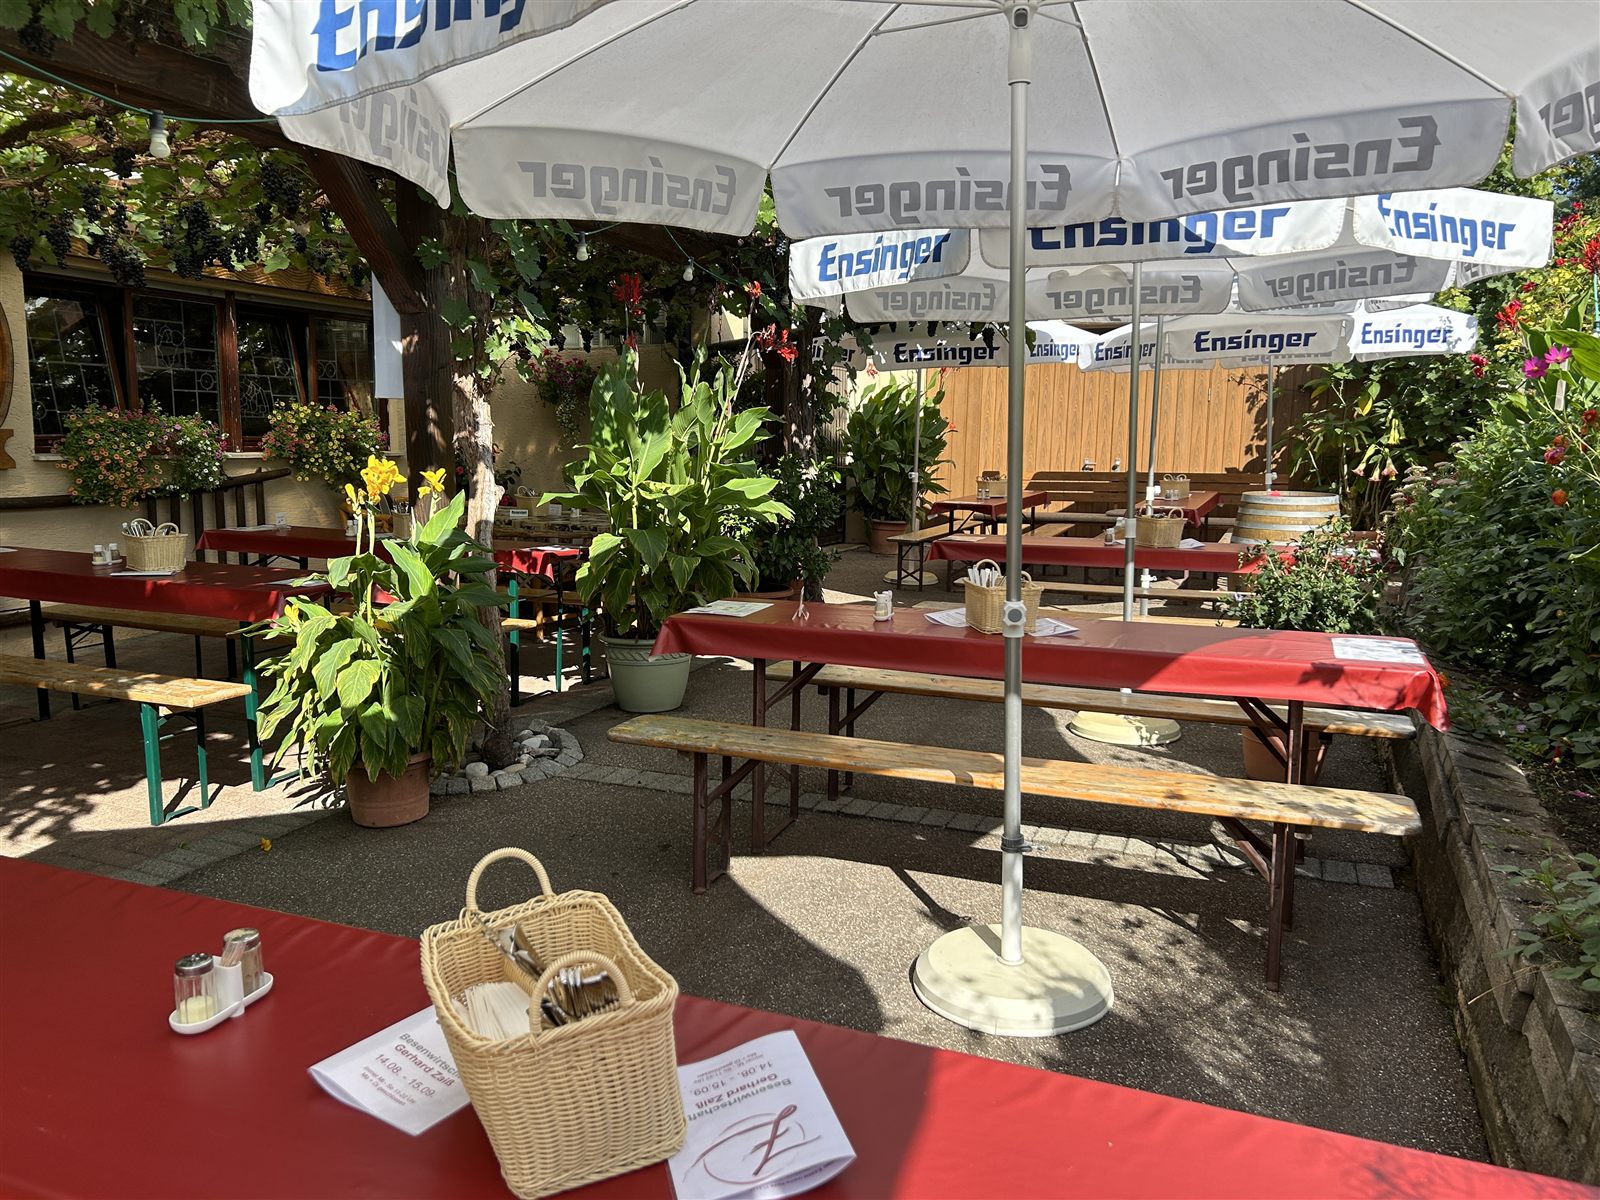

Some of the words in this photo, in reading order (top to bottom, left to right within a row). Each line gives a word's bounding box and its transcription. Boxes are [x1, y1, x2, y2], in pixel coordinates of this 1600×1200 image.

[818, 232, 950, 282] Ensinger
[1193, 329, 1317, 353] Ensinger
[1361, 322, 1453, 348] Ensinger
[893, 342, 1000, 365] Ensinger
[375, 1053, 402, 1077] 14.08.
[408, 1078, 436, 1098] 15.09.
[394, 1043, 434, 1074] Gerhard
[430, 1069, 456, 1088] Zaiß
[737, 1061, 774, 1077] 14.08.
[727, 1073, 779, 1099] Gerhard
[688, 1078, 793, 1122] Besenwirtschaft
[695, 1095, 724, 1109] Zaiß
